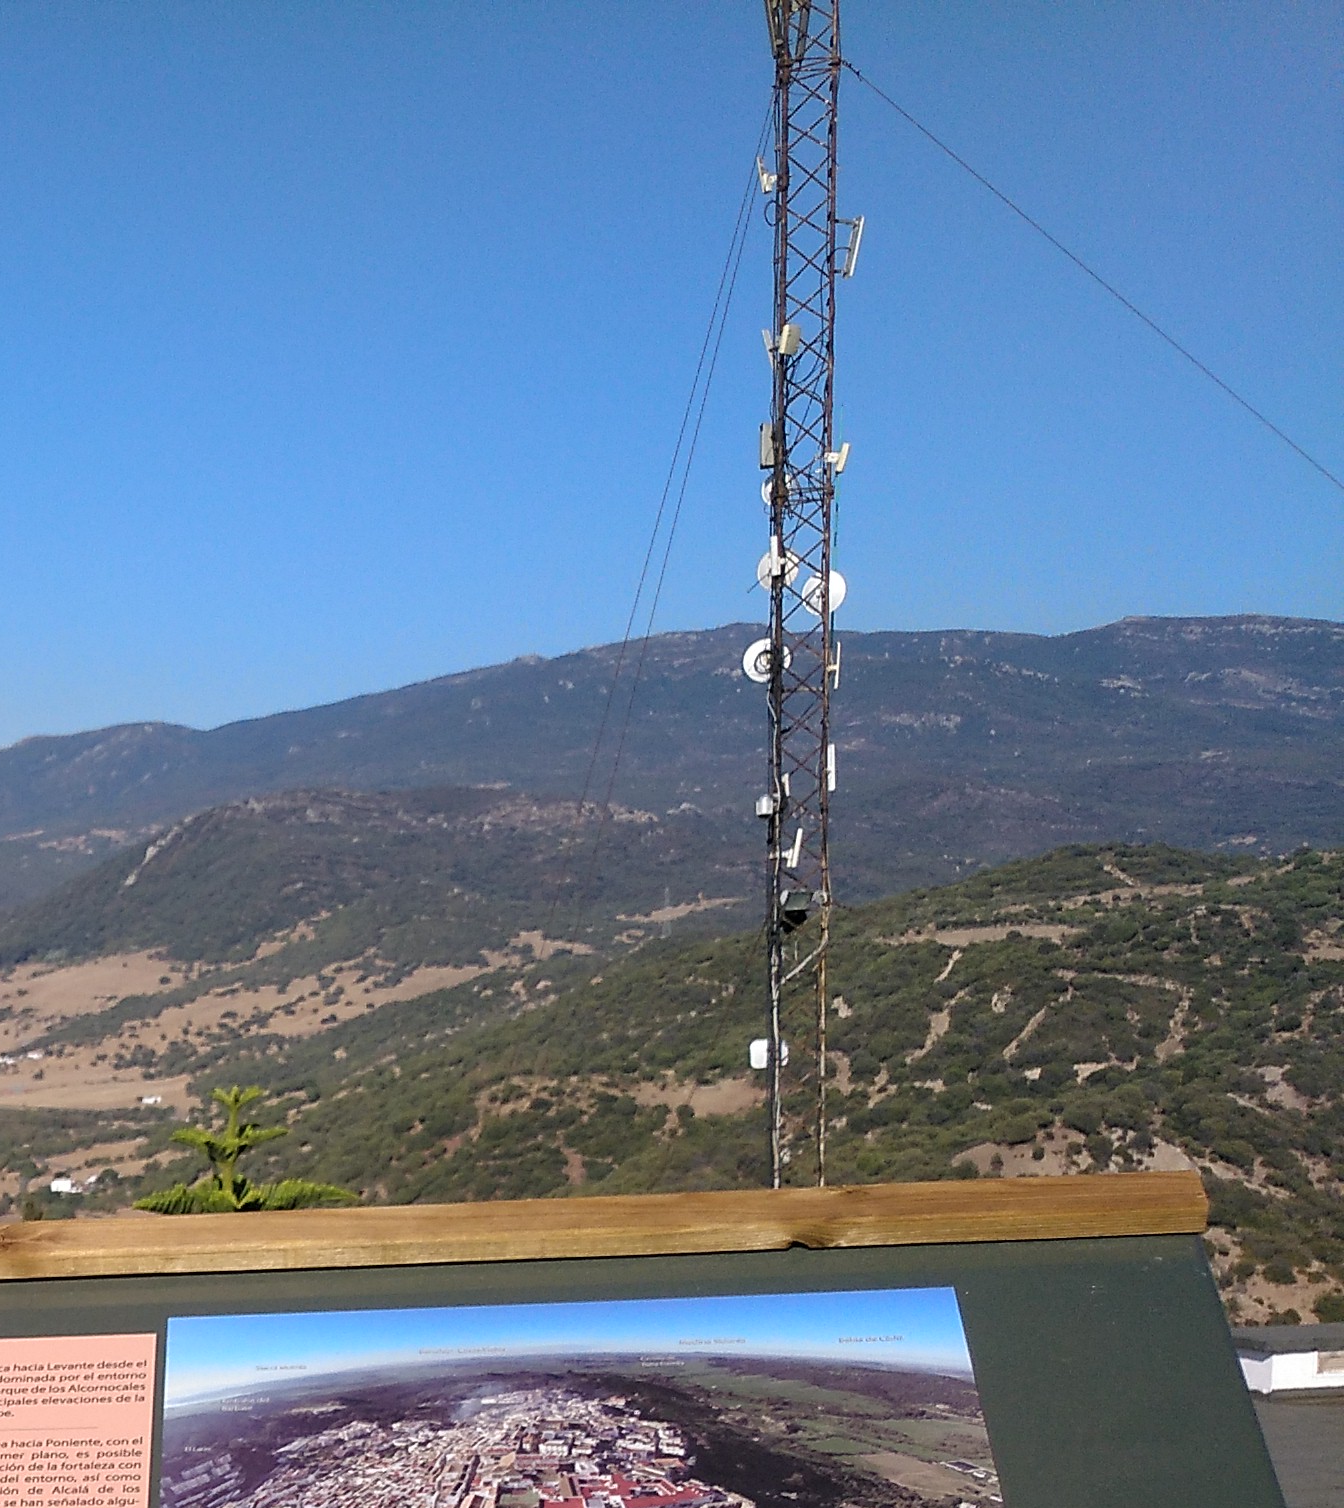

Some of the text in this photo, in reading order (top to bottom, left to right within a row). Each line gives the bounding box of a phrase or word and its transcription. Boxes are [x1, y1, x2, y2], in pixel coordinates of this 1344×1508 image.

[30, 1385, 47, 1394] de
[48, 1385, 65, 1393] los
[68, 1382, 146, 1393] Alcornocales
[10, 1440, 43, 1448] hacia
[46, 1438, 103, 1447] Poniente,
[131, 1436, 143, 1445] el
